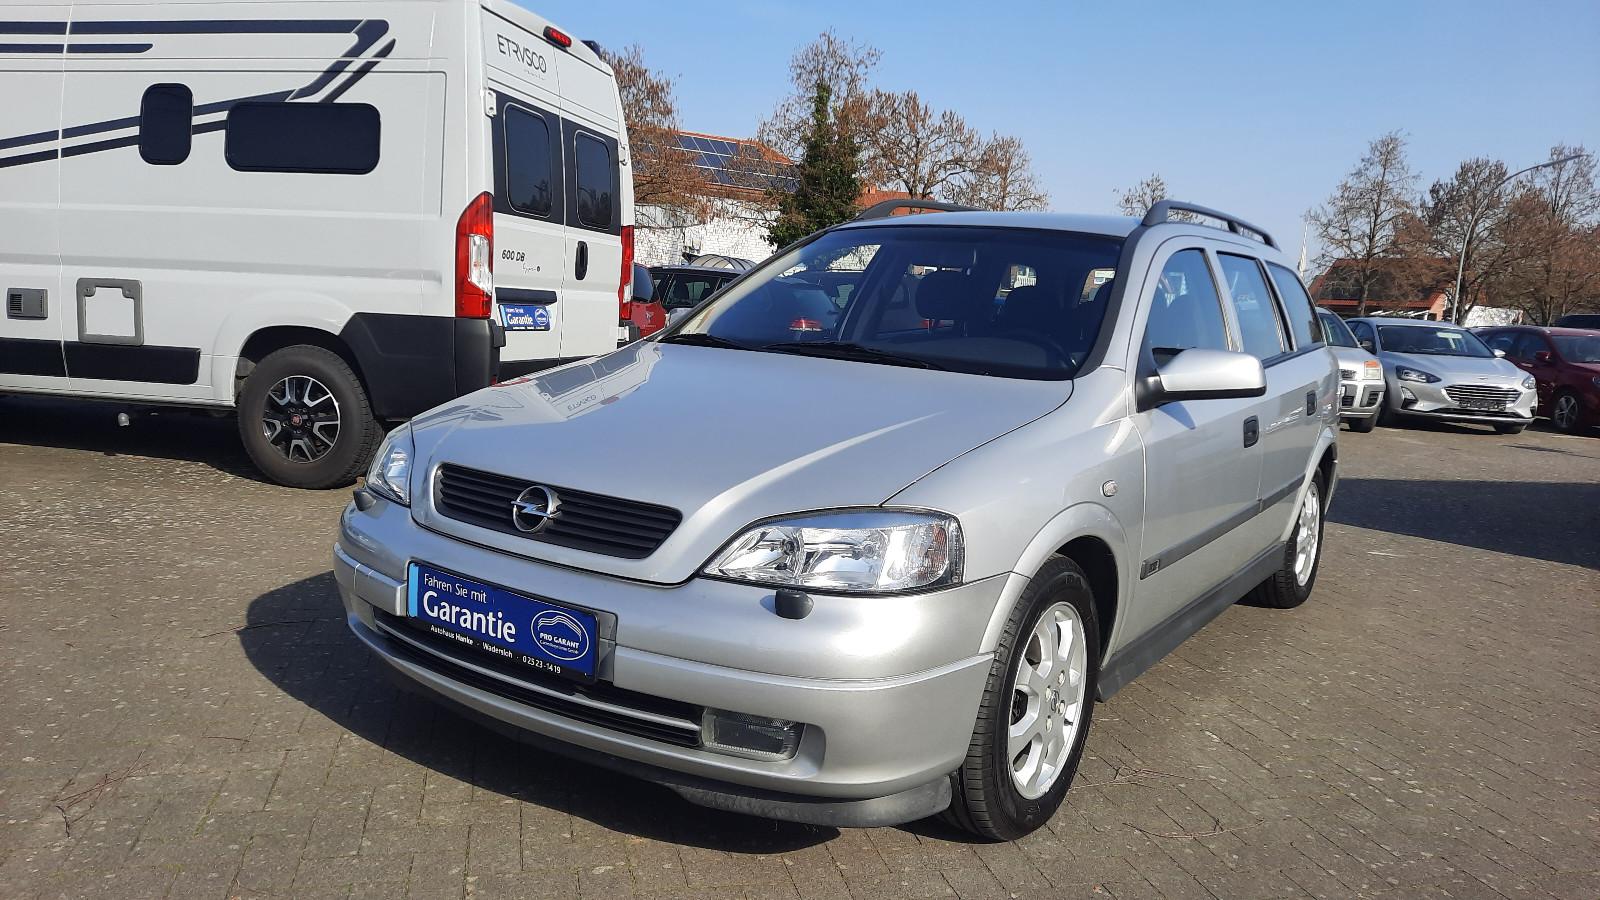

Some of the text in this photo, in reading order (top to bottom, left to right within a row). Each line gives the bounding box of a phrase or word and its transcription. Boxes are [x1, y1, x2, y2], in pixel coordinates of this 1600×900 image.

[501, 249, 525, 261] 600 DB
[507, 313, 534, 325] Garantie
[424, 573, 487, 604] Fahren Sie mit
[423, 590, 516, 643] Garantie
[430, 624, 455, 639] Autohaus
[455, 633, 474, 646] Hanke
[482, 642, 513, 658] Wadersloh
[539, 632, 553, 642] PRO
[553, 636, 580, 649] GARANT
